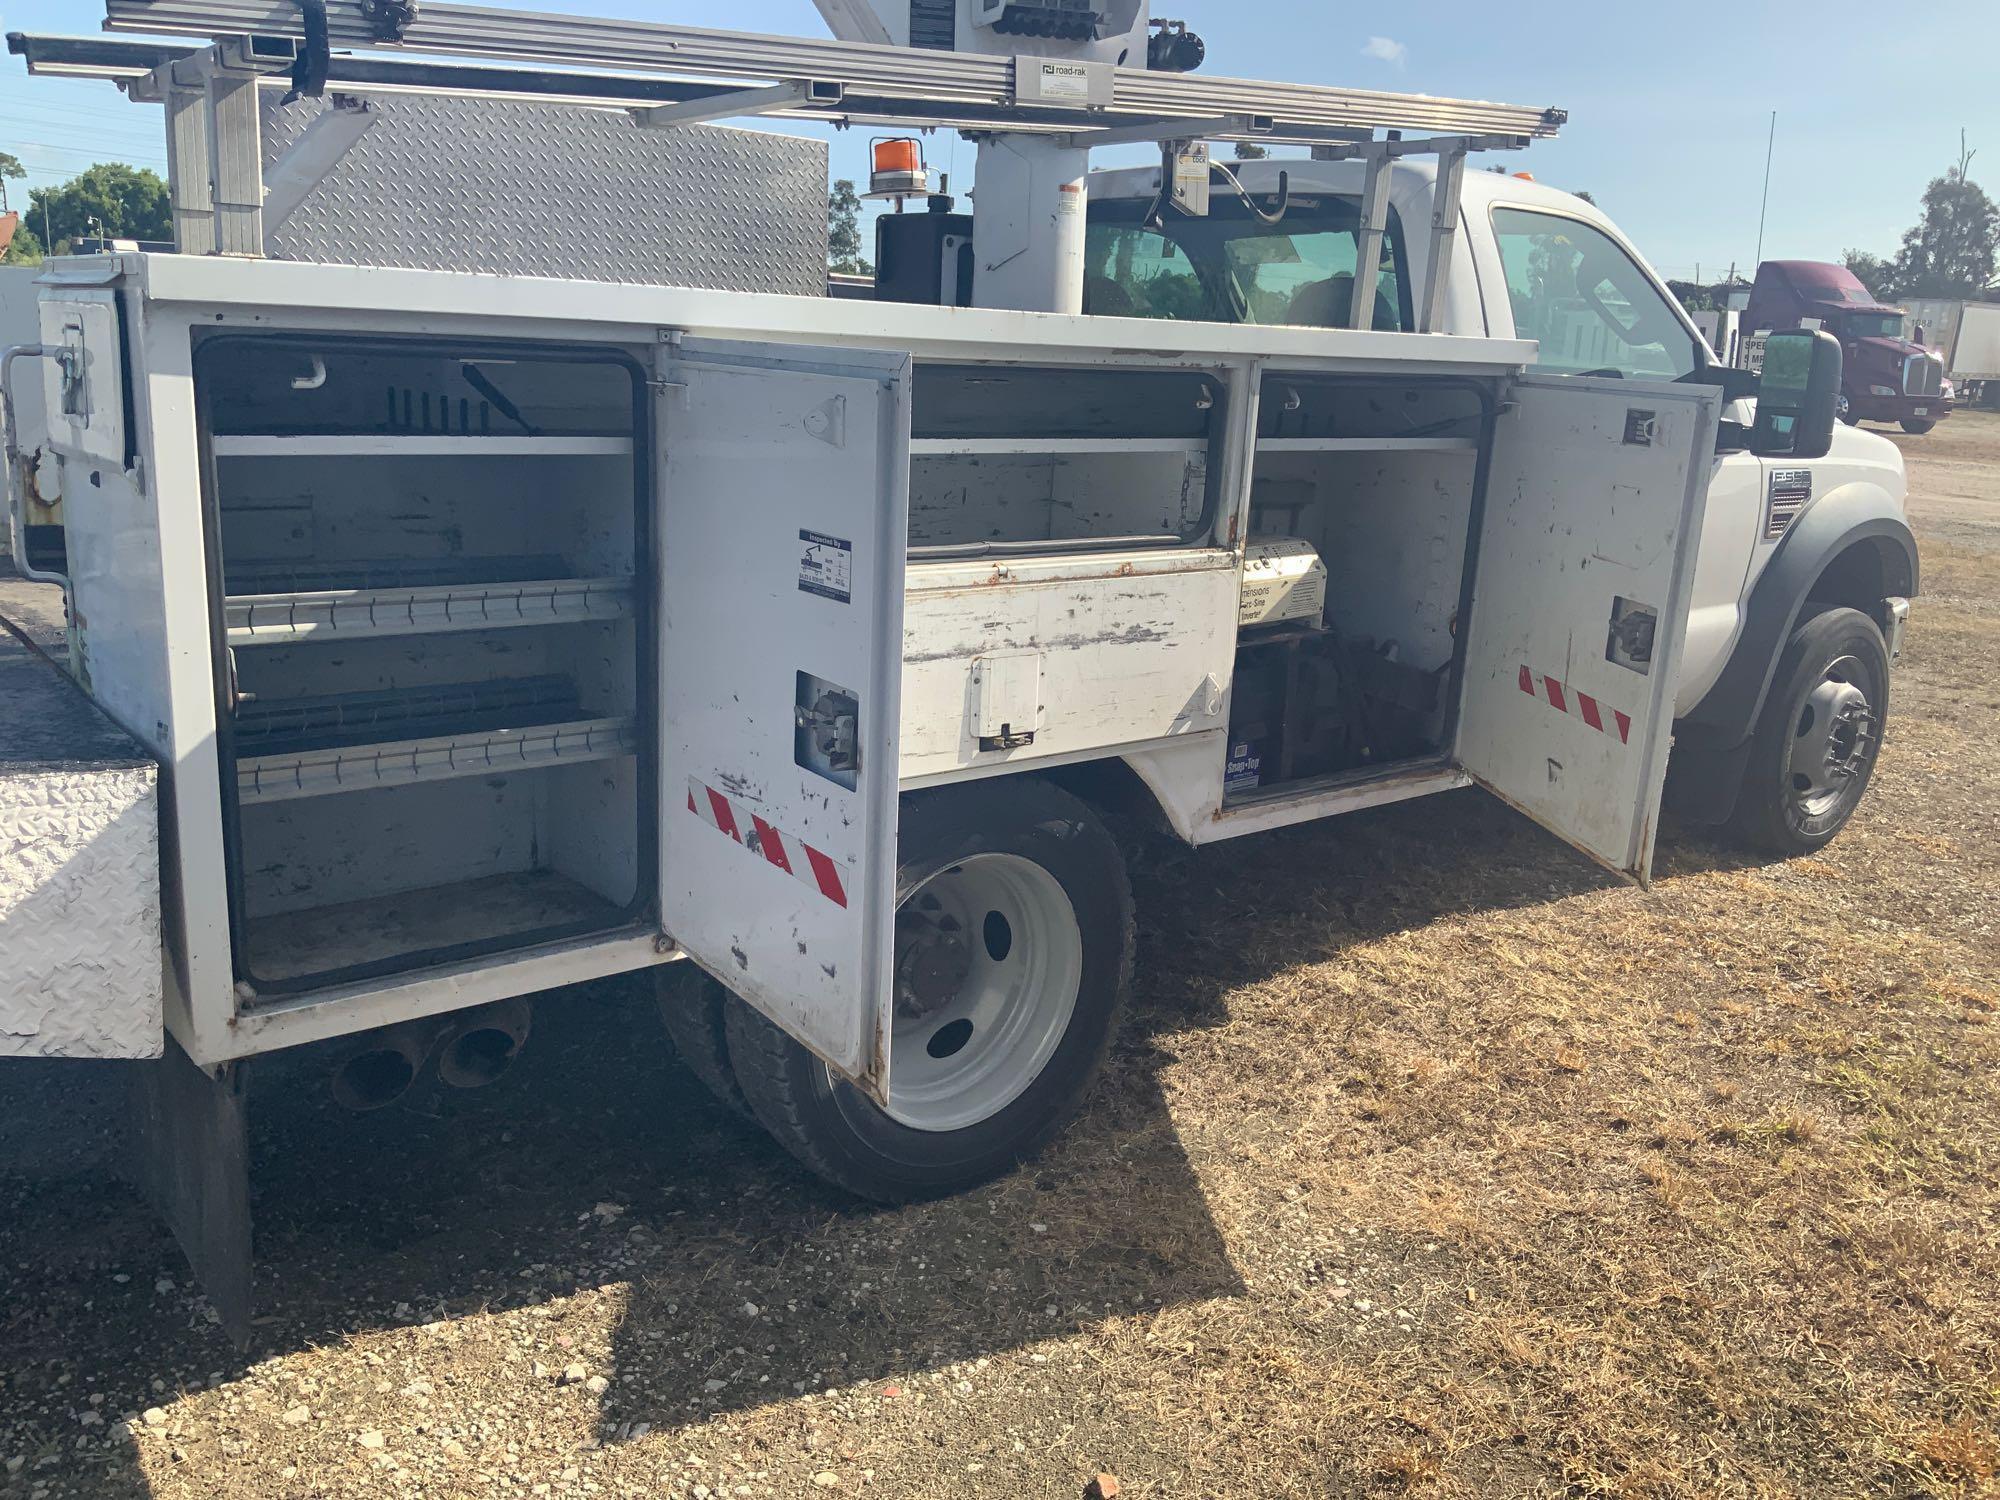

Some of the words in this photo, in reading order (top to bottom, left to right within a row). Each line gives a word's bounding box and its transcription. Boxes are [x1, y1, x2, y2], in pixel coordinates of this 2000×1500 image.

[1056, 66, 1087, 76] road-rak
[1744, 340, 1766, 350] SPEE
[1751, 354, 1765, 364] MP
[809, 533, 833, 546] Inspected
[833, 538, 841, 549] By
[1241, 587, 1270, 598] mensions
[1241, 610, 1262, 621] Inverter
